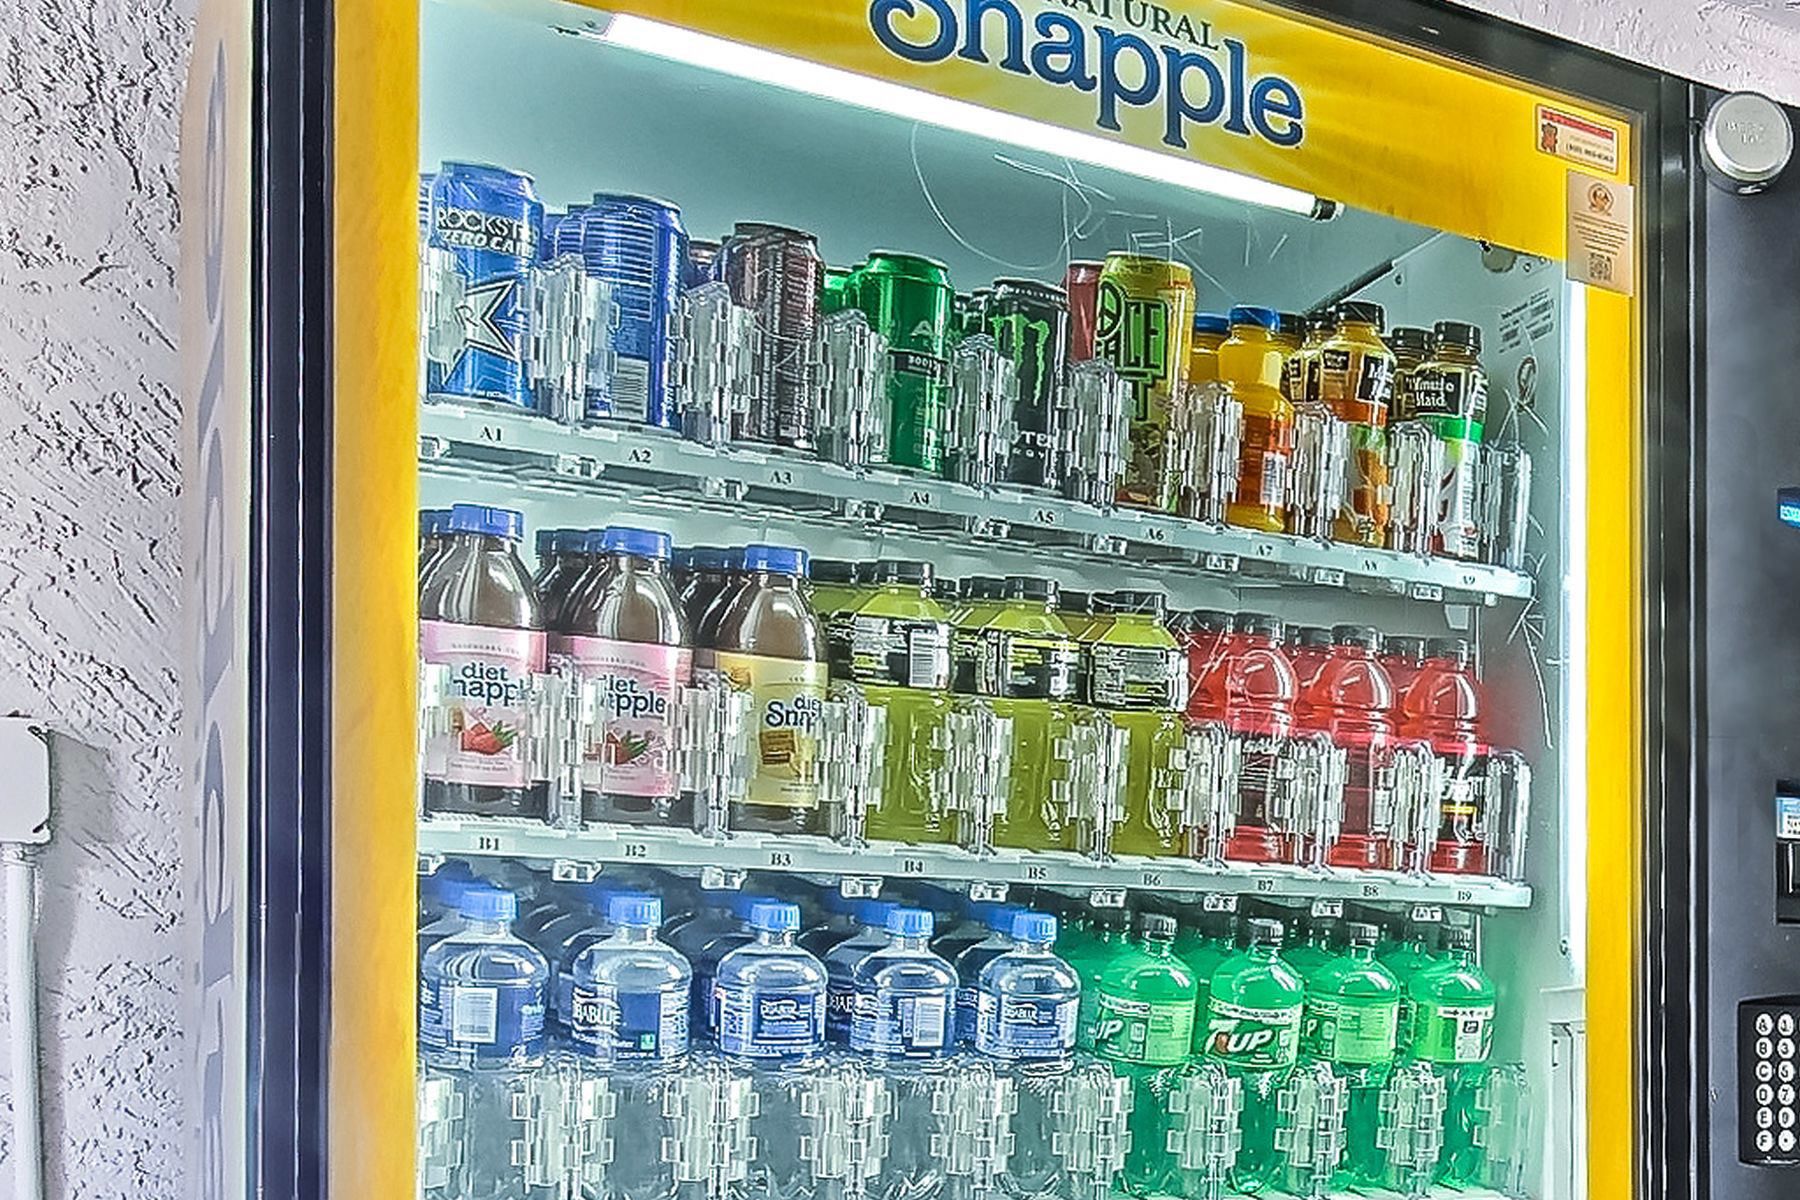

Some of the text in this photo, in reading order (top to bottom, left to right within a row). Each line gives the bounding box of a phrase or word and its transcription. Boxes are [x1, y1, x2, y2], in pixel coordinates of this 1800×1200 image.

[869, 0, 1306, 149] Snapple
[480, 427, 502, 442] A1
[629, 449, 652, 464] A2
[770, 471, 792, 486] A3
[910, 491, 931, 506] A4
[1035, 509, 1055, 524] A5
[1145, 527, 1164, 541] A6
[1256, 544, 1274, 558] A7
[462, 662, 508, 682] diet
[479, 837, 500, 850] B1
[625, 844, 646, 857] B2
[771, 853, 791, 866] B3
[904, 860, 924, 873] B4
[1028, 867, 1047, 879] B5
[1143, 873, 1161, 885] B6
[1257, 880, 1274, 892] B7
[1088, 1019, 1124, 1041] UP
[1205, 1019, 1274, 1055] 7UP
